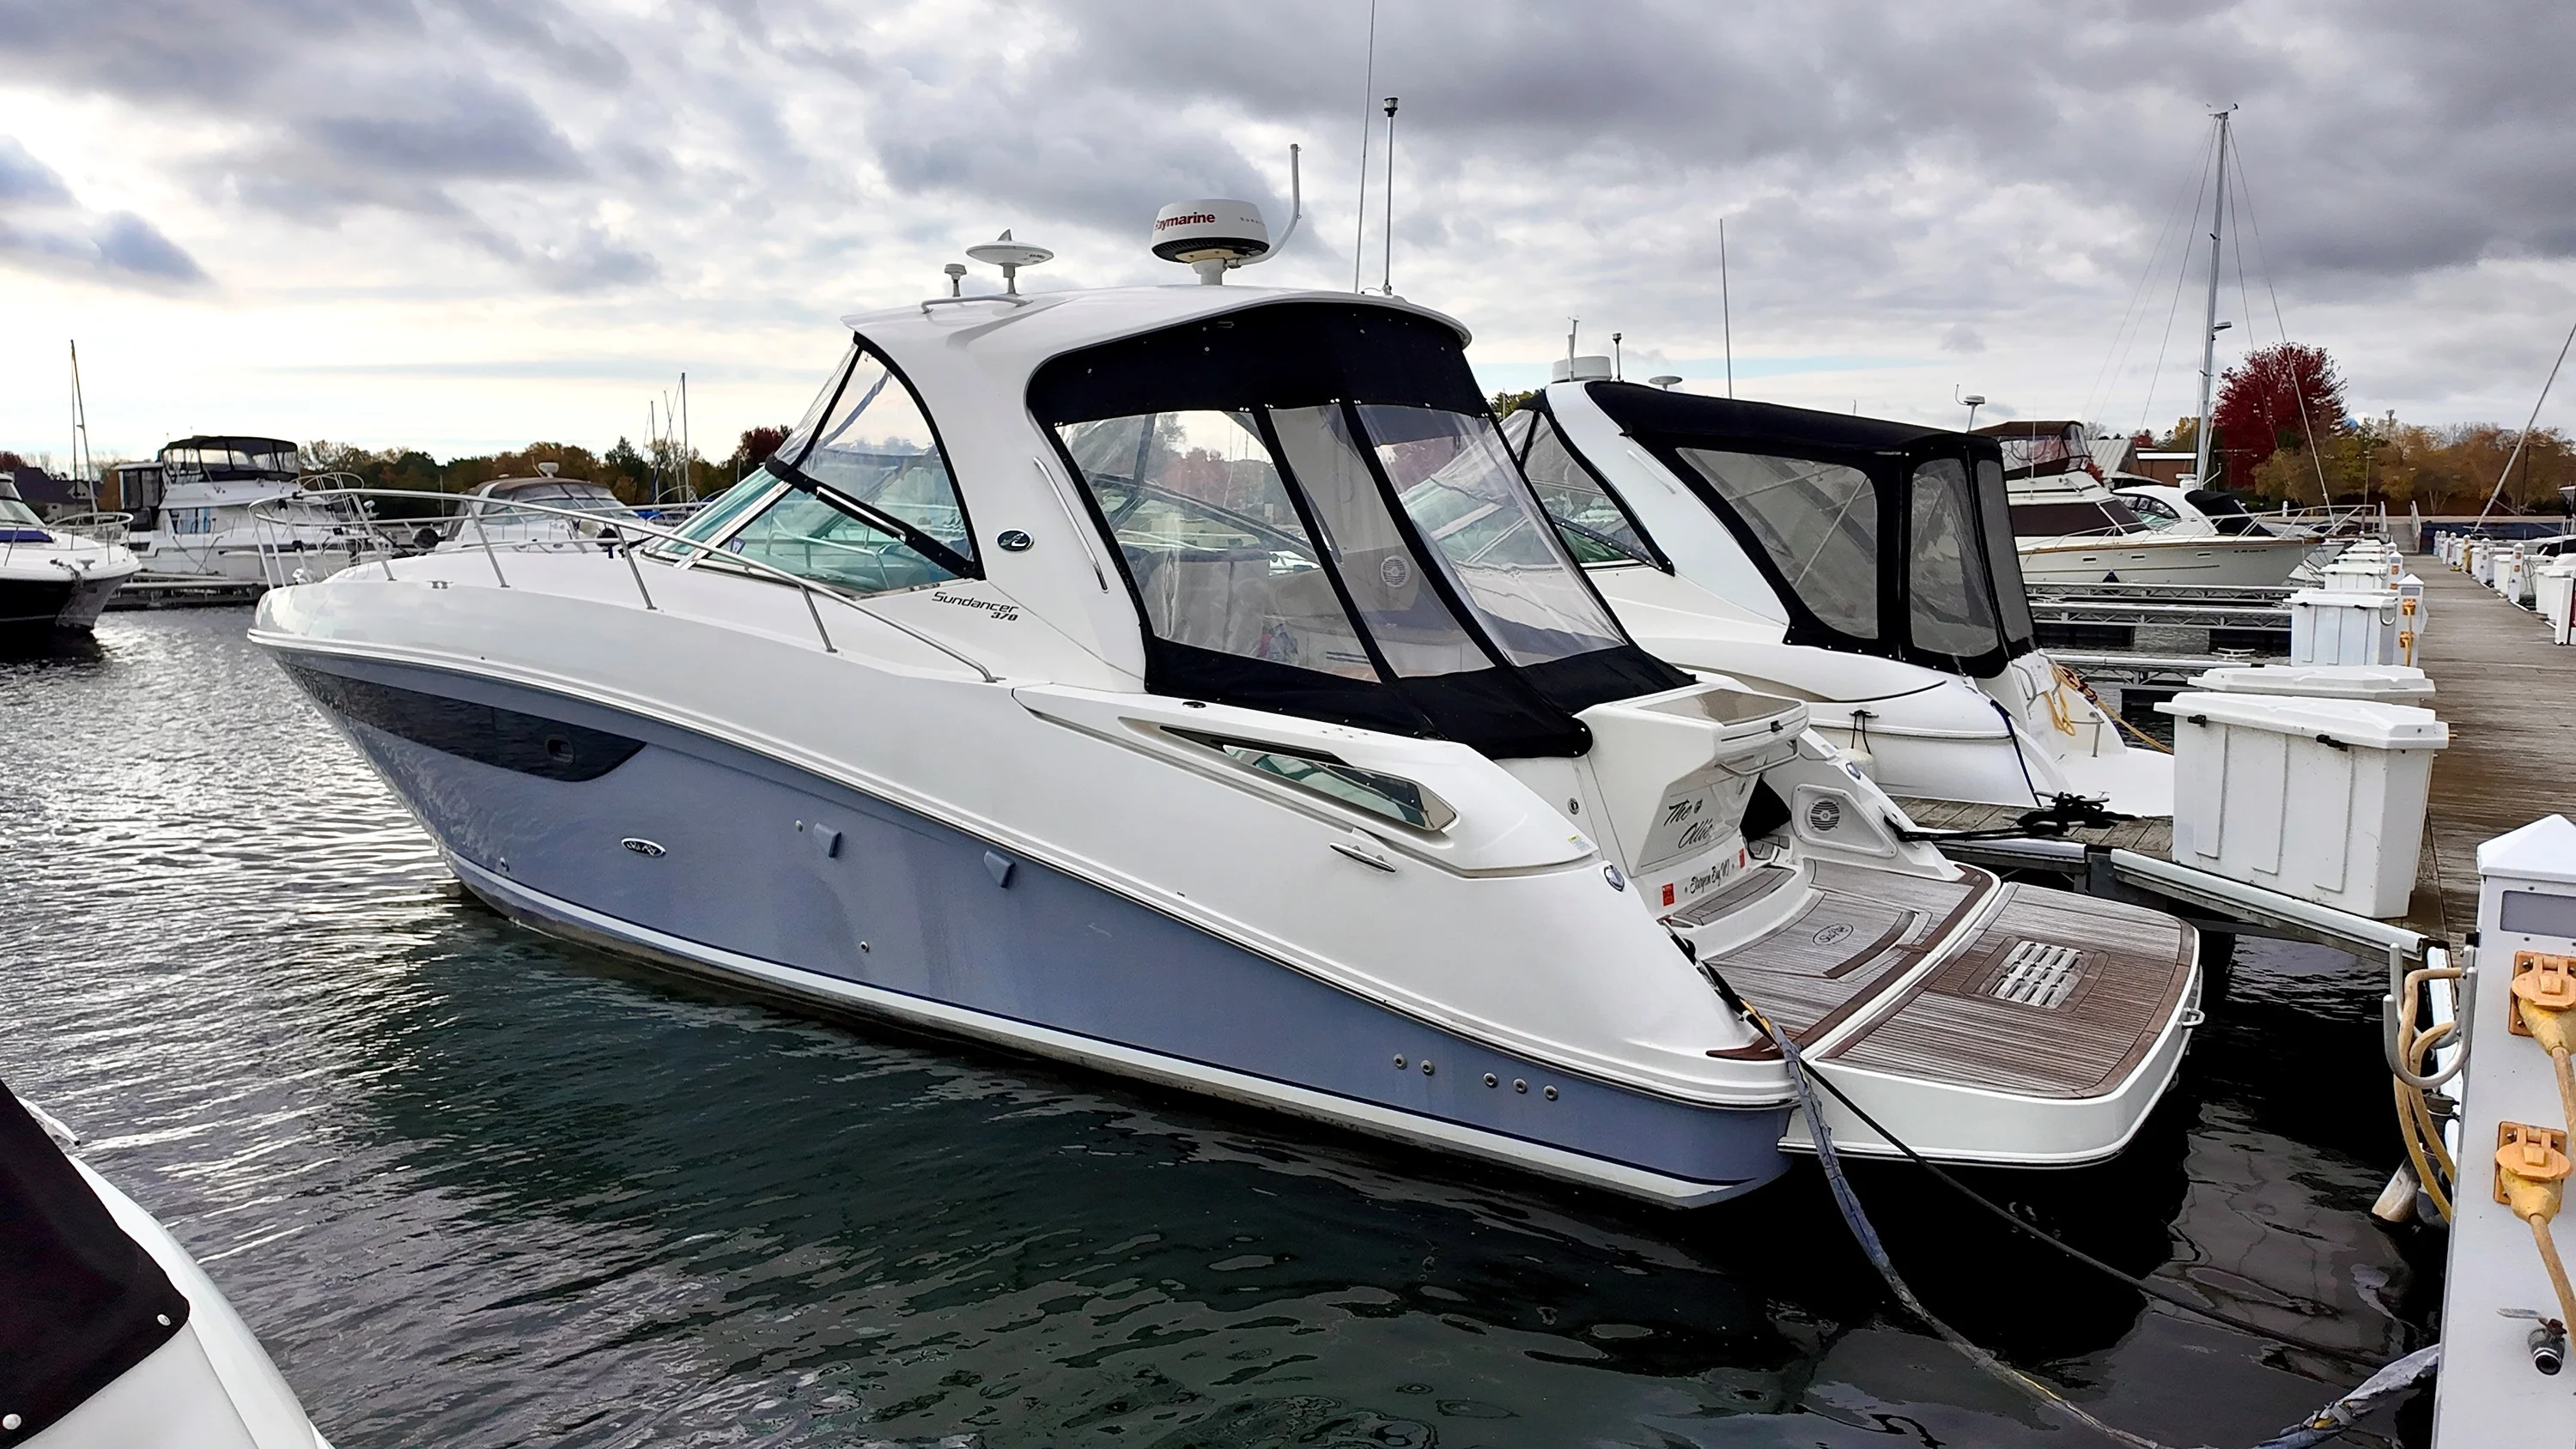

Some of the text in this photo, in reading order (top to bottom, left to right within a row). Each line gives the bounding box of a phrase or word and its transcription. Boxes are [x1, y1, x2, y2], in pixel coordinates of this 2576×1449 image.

[932, 591, 1019, 613] Sundancer
[991, 611, 1018, 621] 370
[1663, 798, 1692, 827] The
